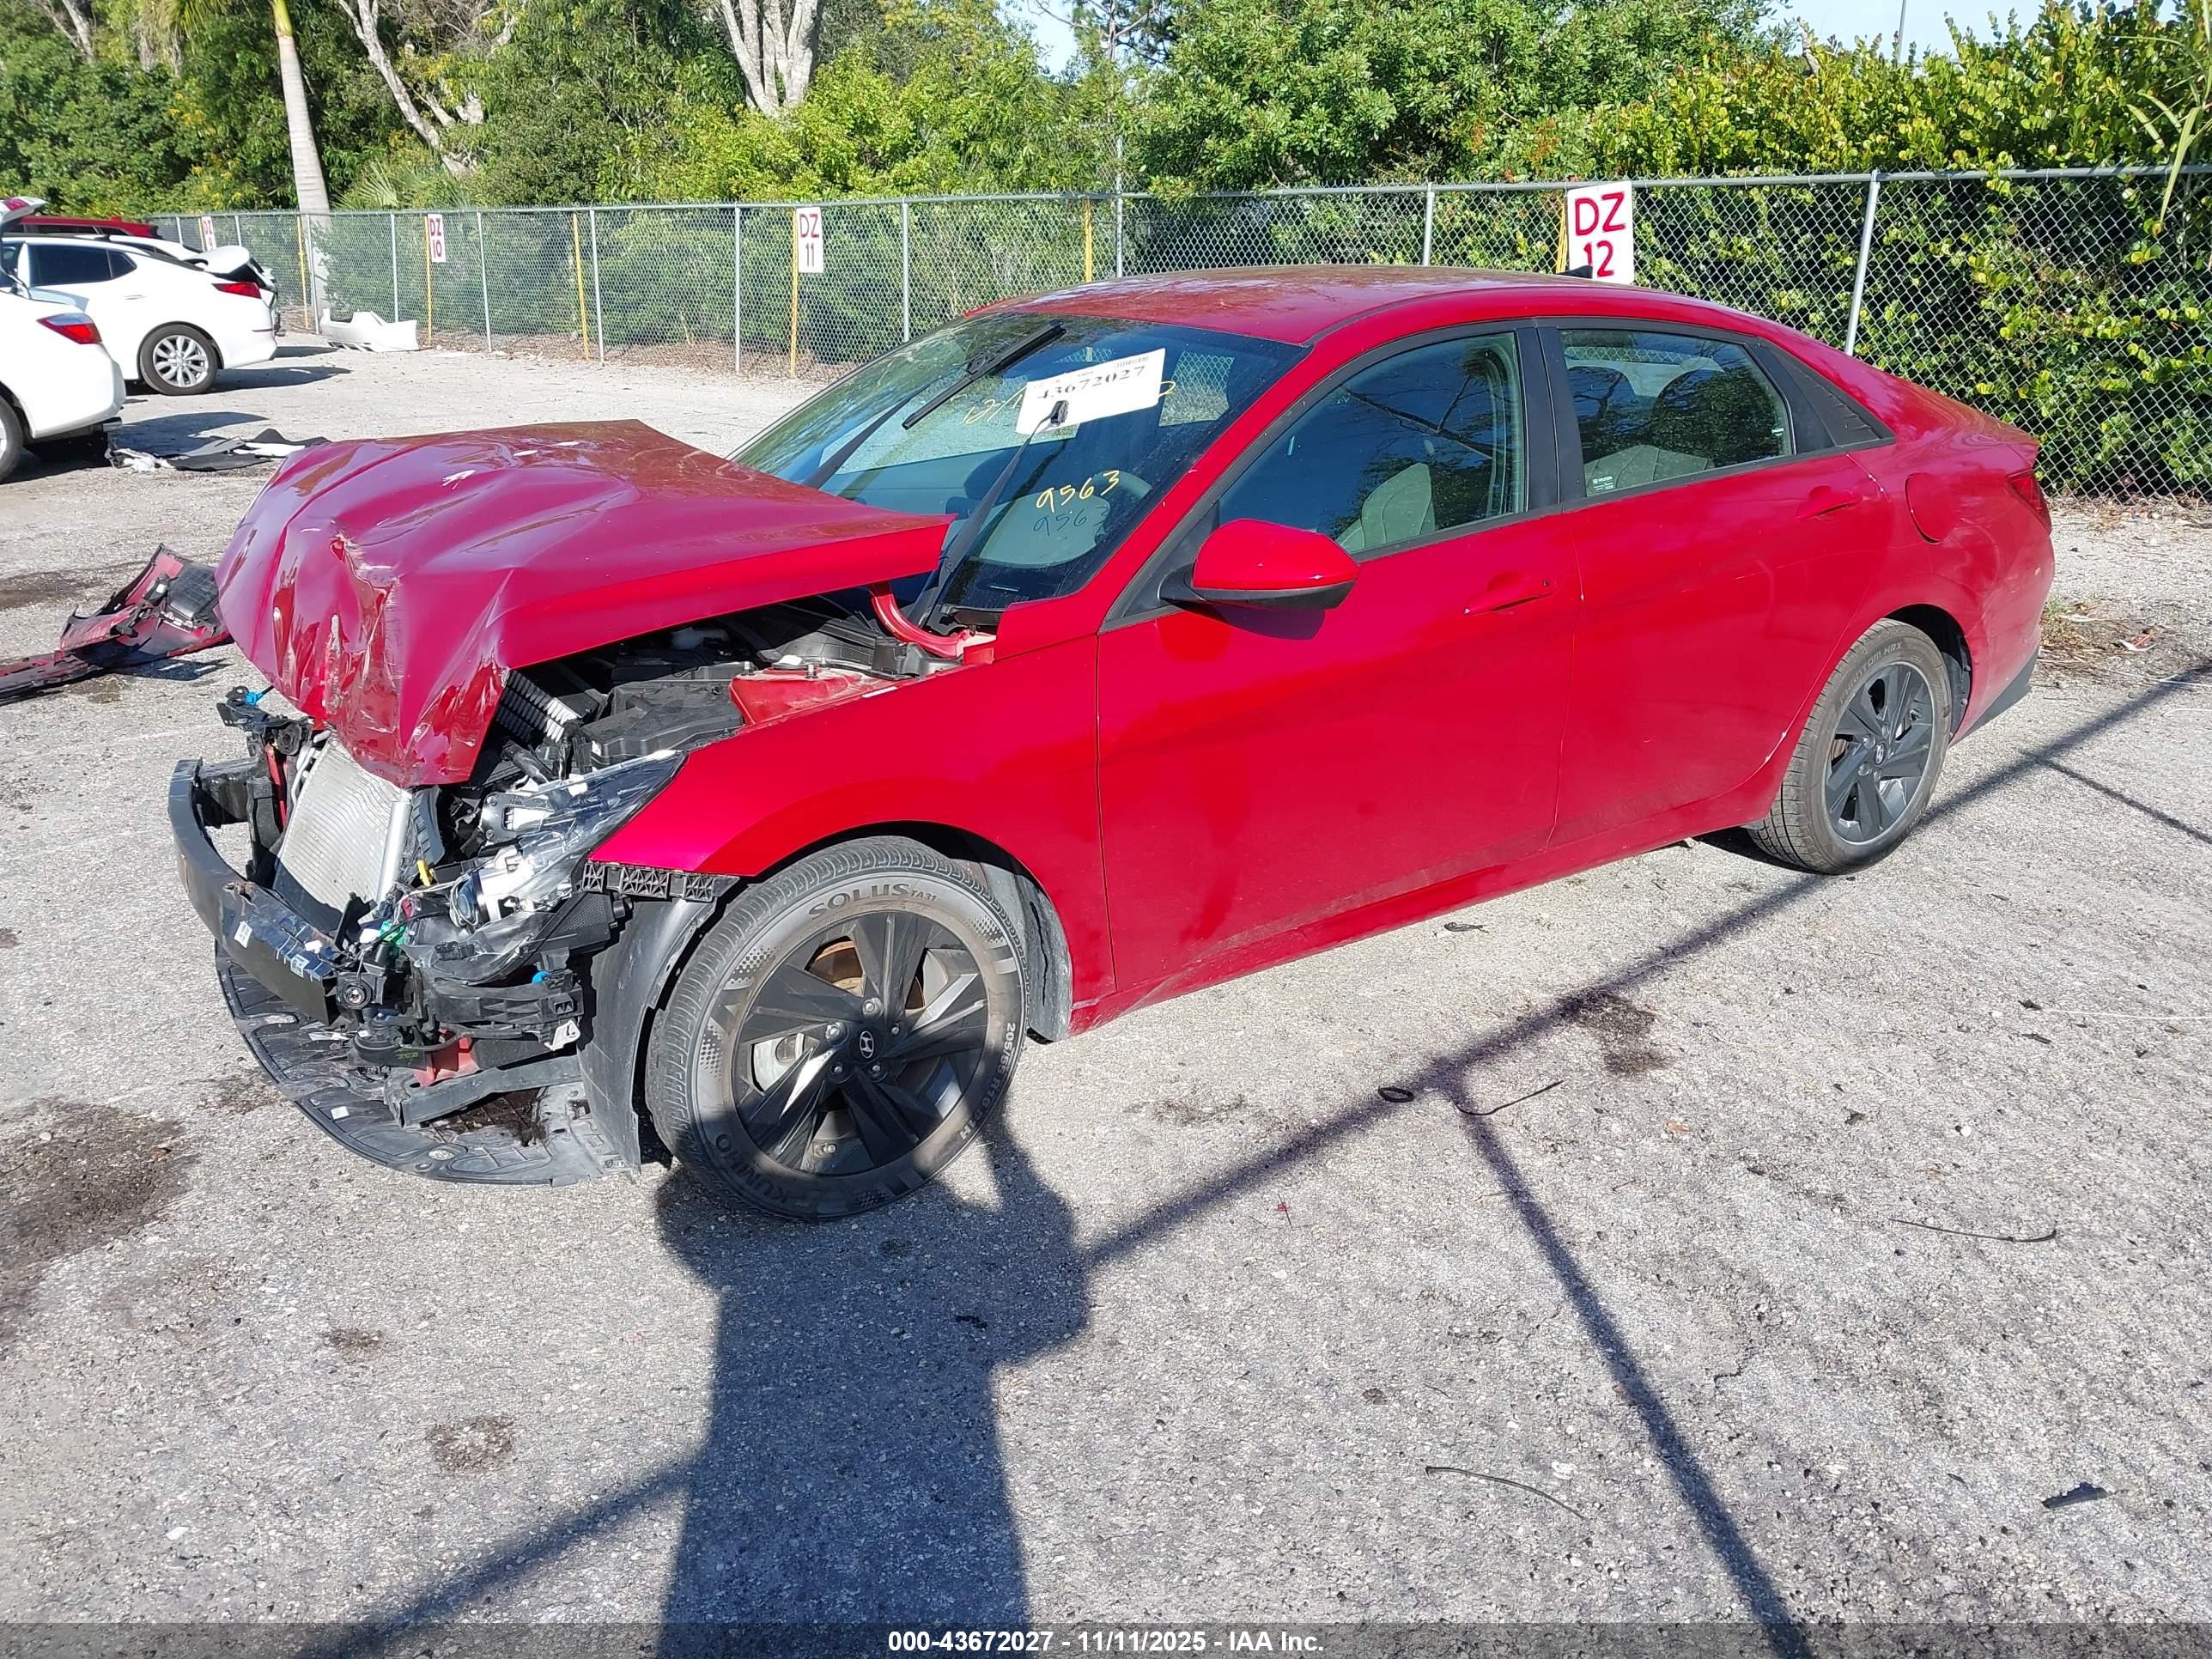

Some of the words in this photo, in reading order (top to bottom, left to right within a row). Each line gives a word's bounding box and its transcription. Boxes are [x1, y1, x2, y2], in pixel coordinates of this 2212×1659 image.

[429, 218, 442, 236] DZ
[799, 213, 820, 238] DZ
[1575, 191, 1626, 236] DZ
[432, 239, 442, 258] 10
[805, 242, 815, 268] 11
[1583, 240, 1614, 277] 12
[1036, 470, 1120, 514] 9563
[808, 884, 910, 921] SOLUS
[910, 889, 938, 902] TA31
[997, 1023, 1016, 1073] 205/55
[716, 1133, 788, 1203] KUMHO
